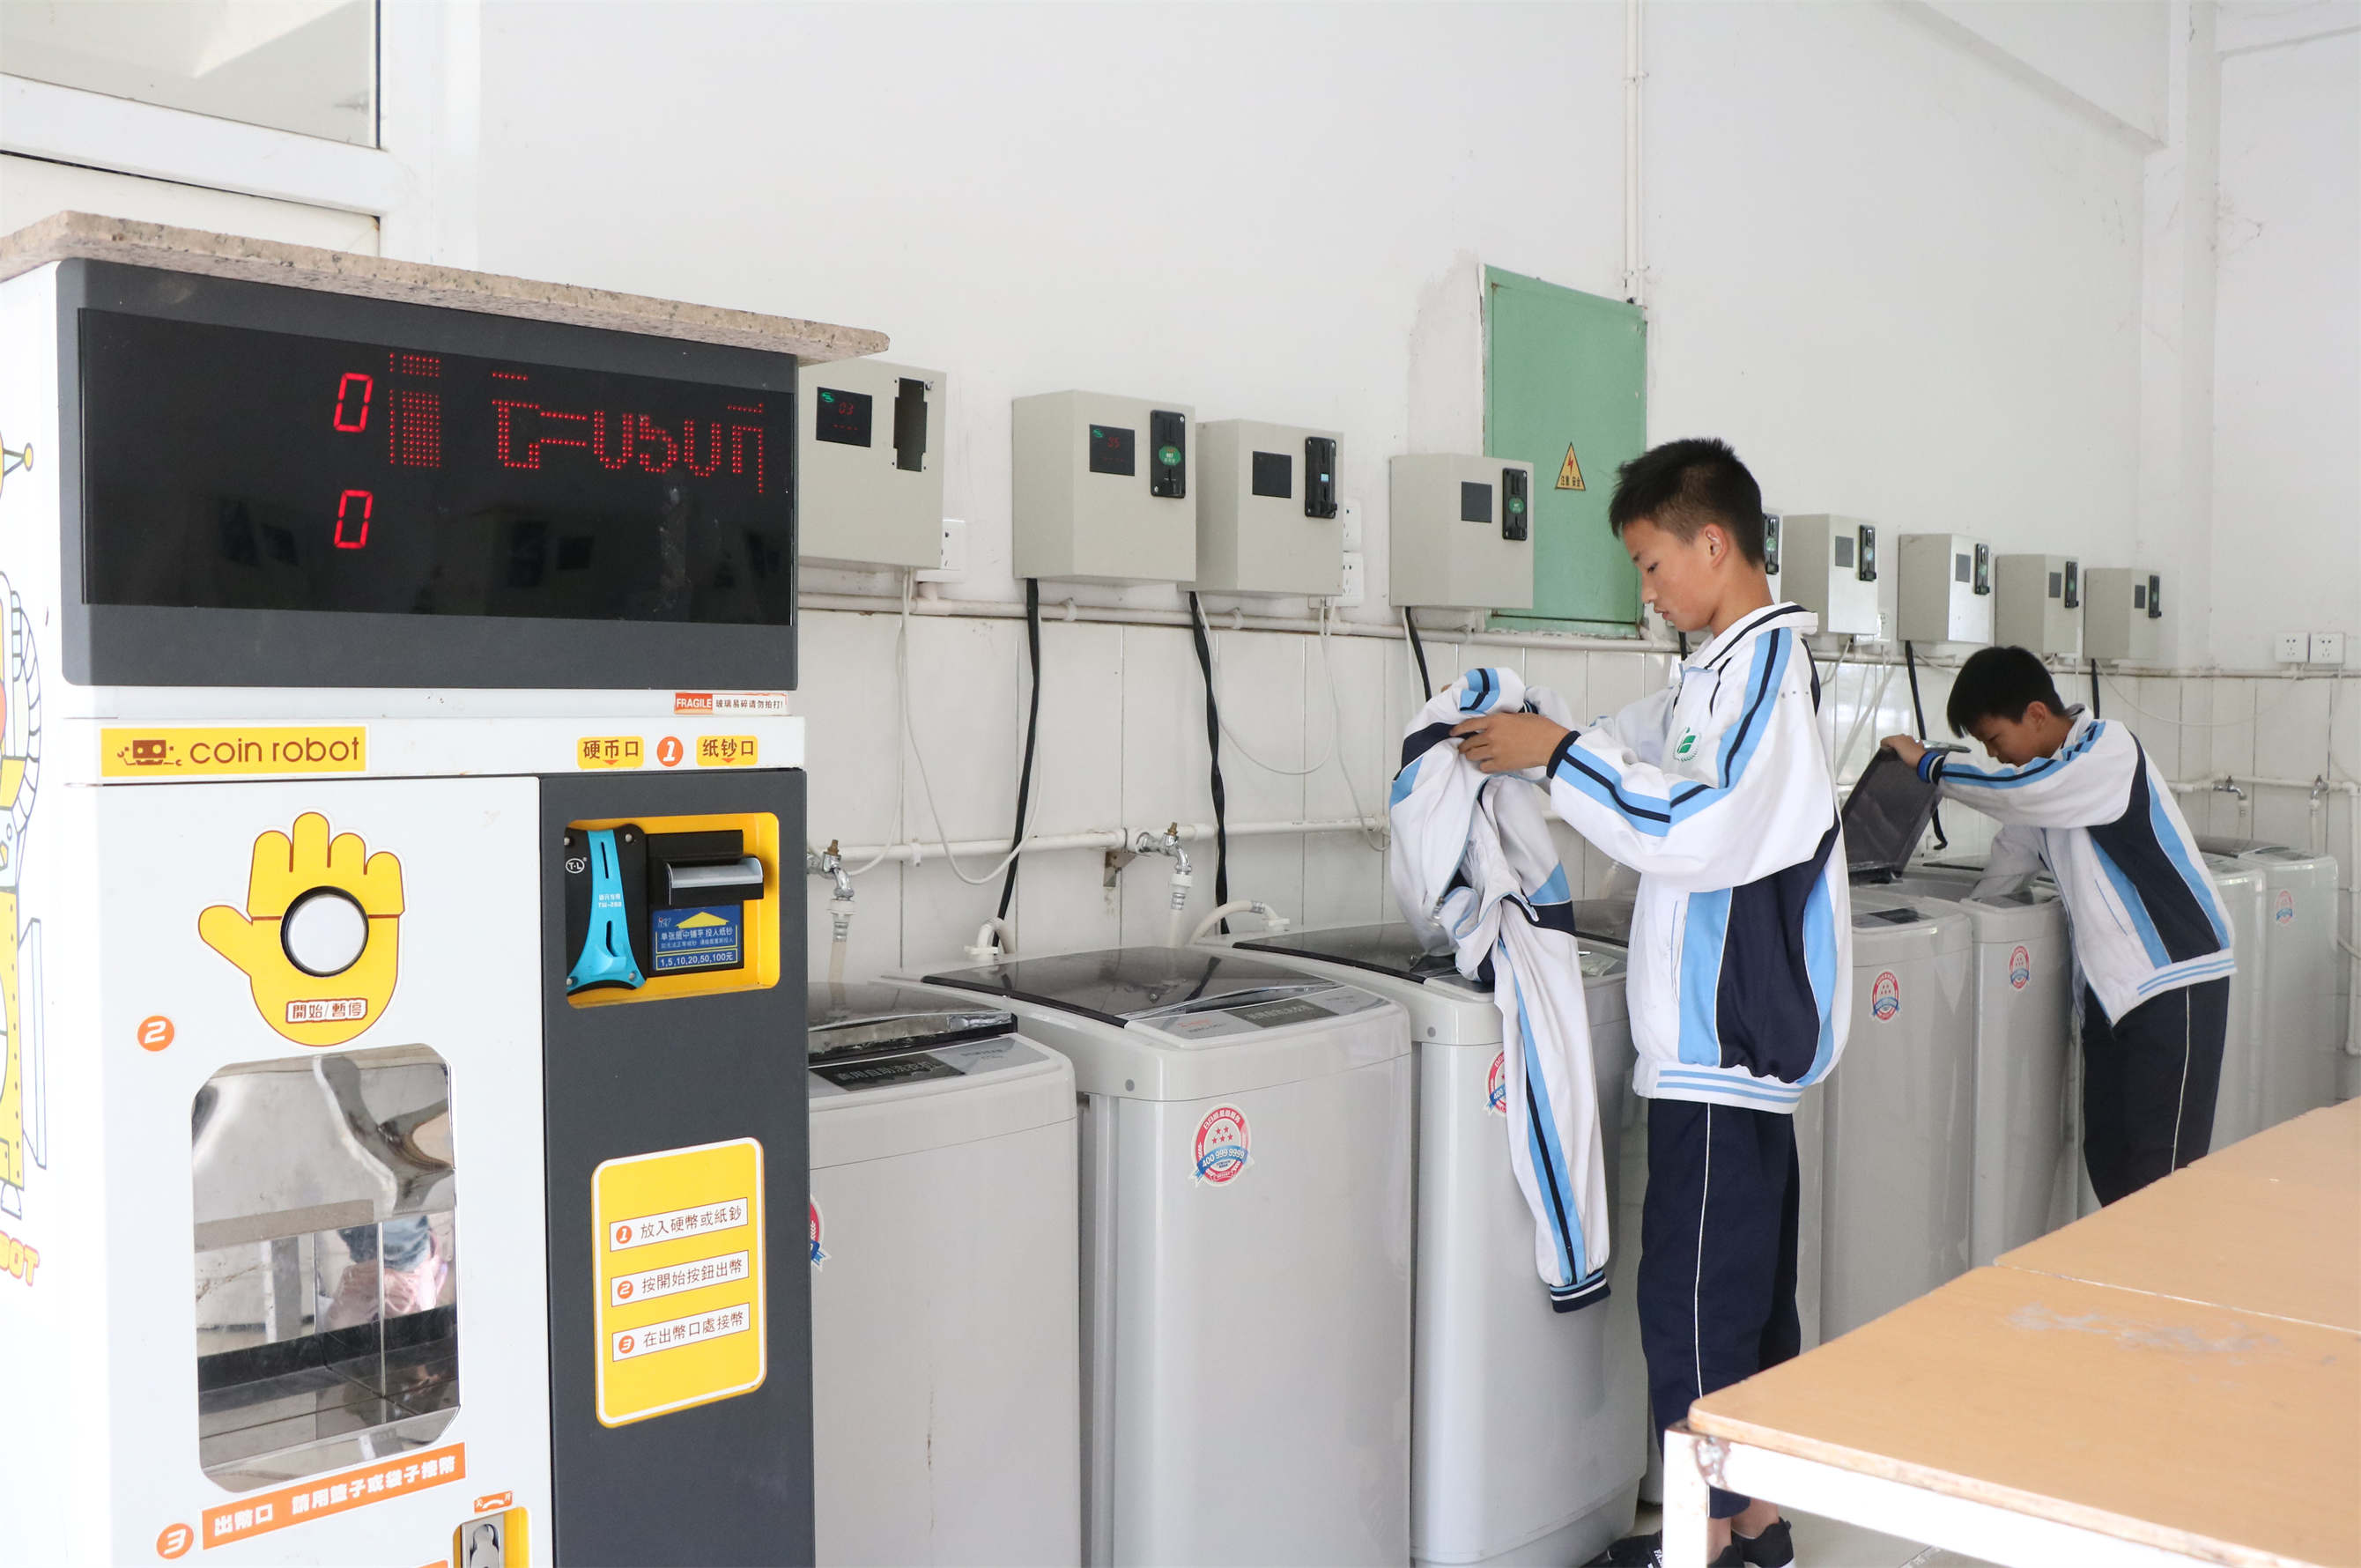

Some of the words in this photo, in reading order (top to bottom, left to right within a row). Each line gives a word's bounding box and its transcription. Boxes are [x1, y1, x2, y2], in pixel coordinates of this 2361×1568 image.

[676, 698, 712, 708] FRAGILE
[189, 738, 263, 764] coin
[272, 737, 359, 763] robot
[583, 739, 639, 759] 硬币口
[702, 738, 754, 758] 纸钞口
[144, 1020, 167, 1044] 2
[640, 1205, 742, 1239] 放入硬幣或紙鈔
[641, 1258, 743, 1294] 按開始按鈕出幣
[643, 1311, 744, 1348] 在出幣口處接幣
[214, 1504, 273, 1536] 出幣口
[164, 1530, 187, 1554] 3
